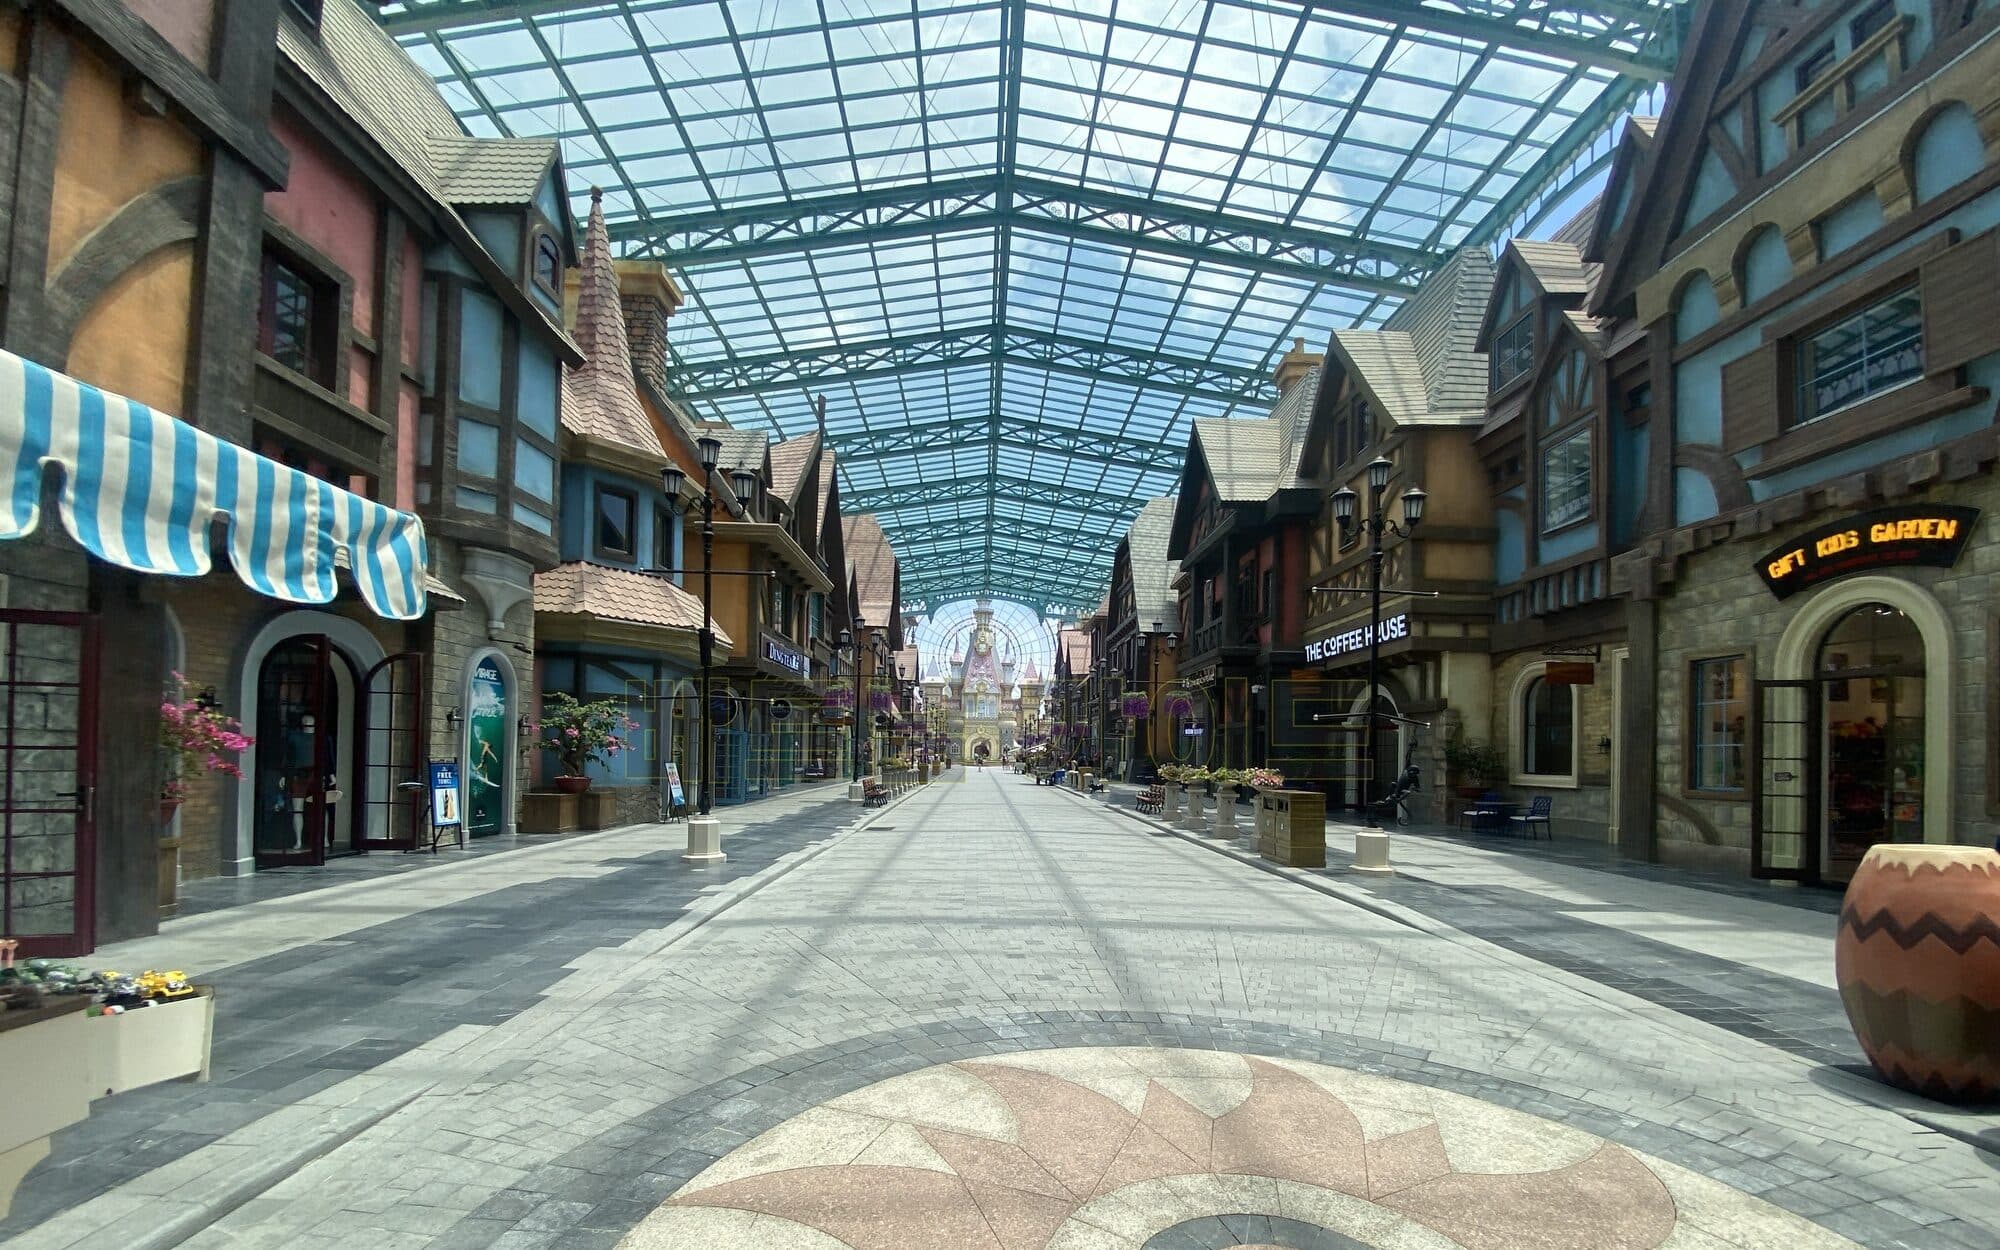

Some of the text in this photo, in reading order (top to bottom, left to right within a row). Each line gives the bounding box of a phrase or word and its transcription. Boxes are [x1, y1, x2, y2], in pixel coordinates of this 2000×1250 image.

[1768, 548, 1806, 579] GIFT
[1816, 530, 1860, 558] KIDS
[1870, 519, 1958, 543] GARDEN
[1304, 614, 1407, 663] THE COFFEE HUSE
